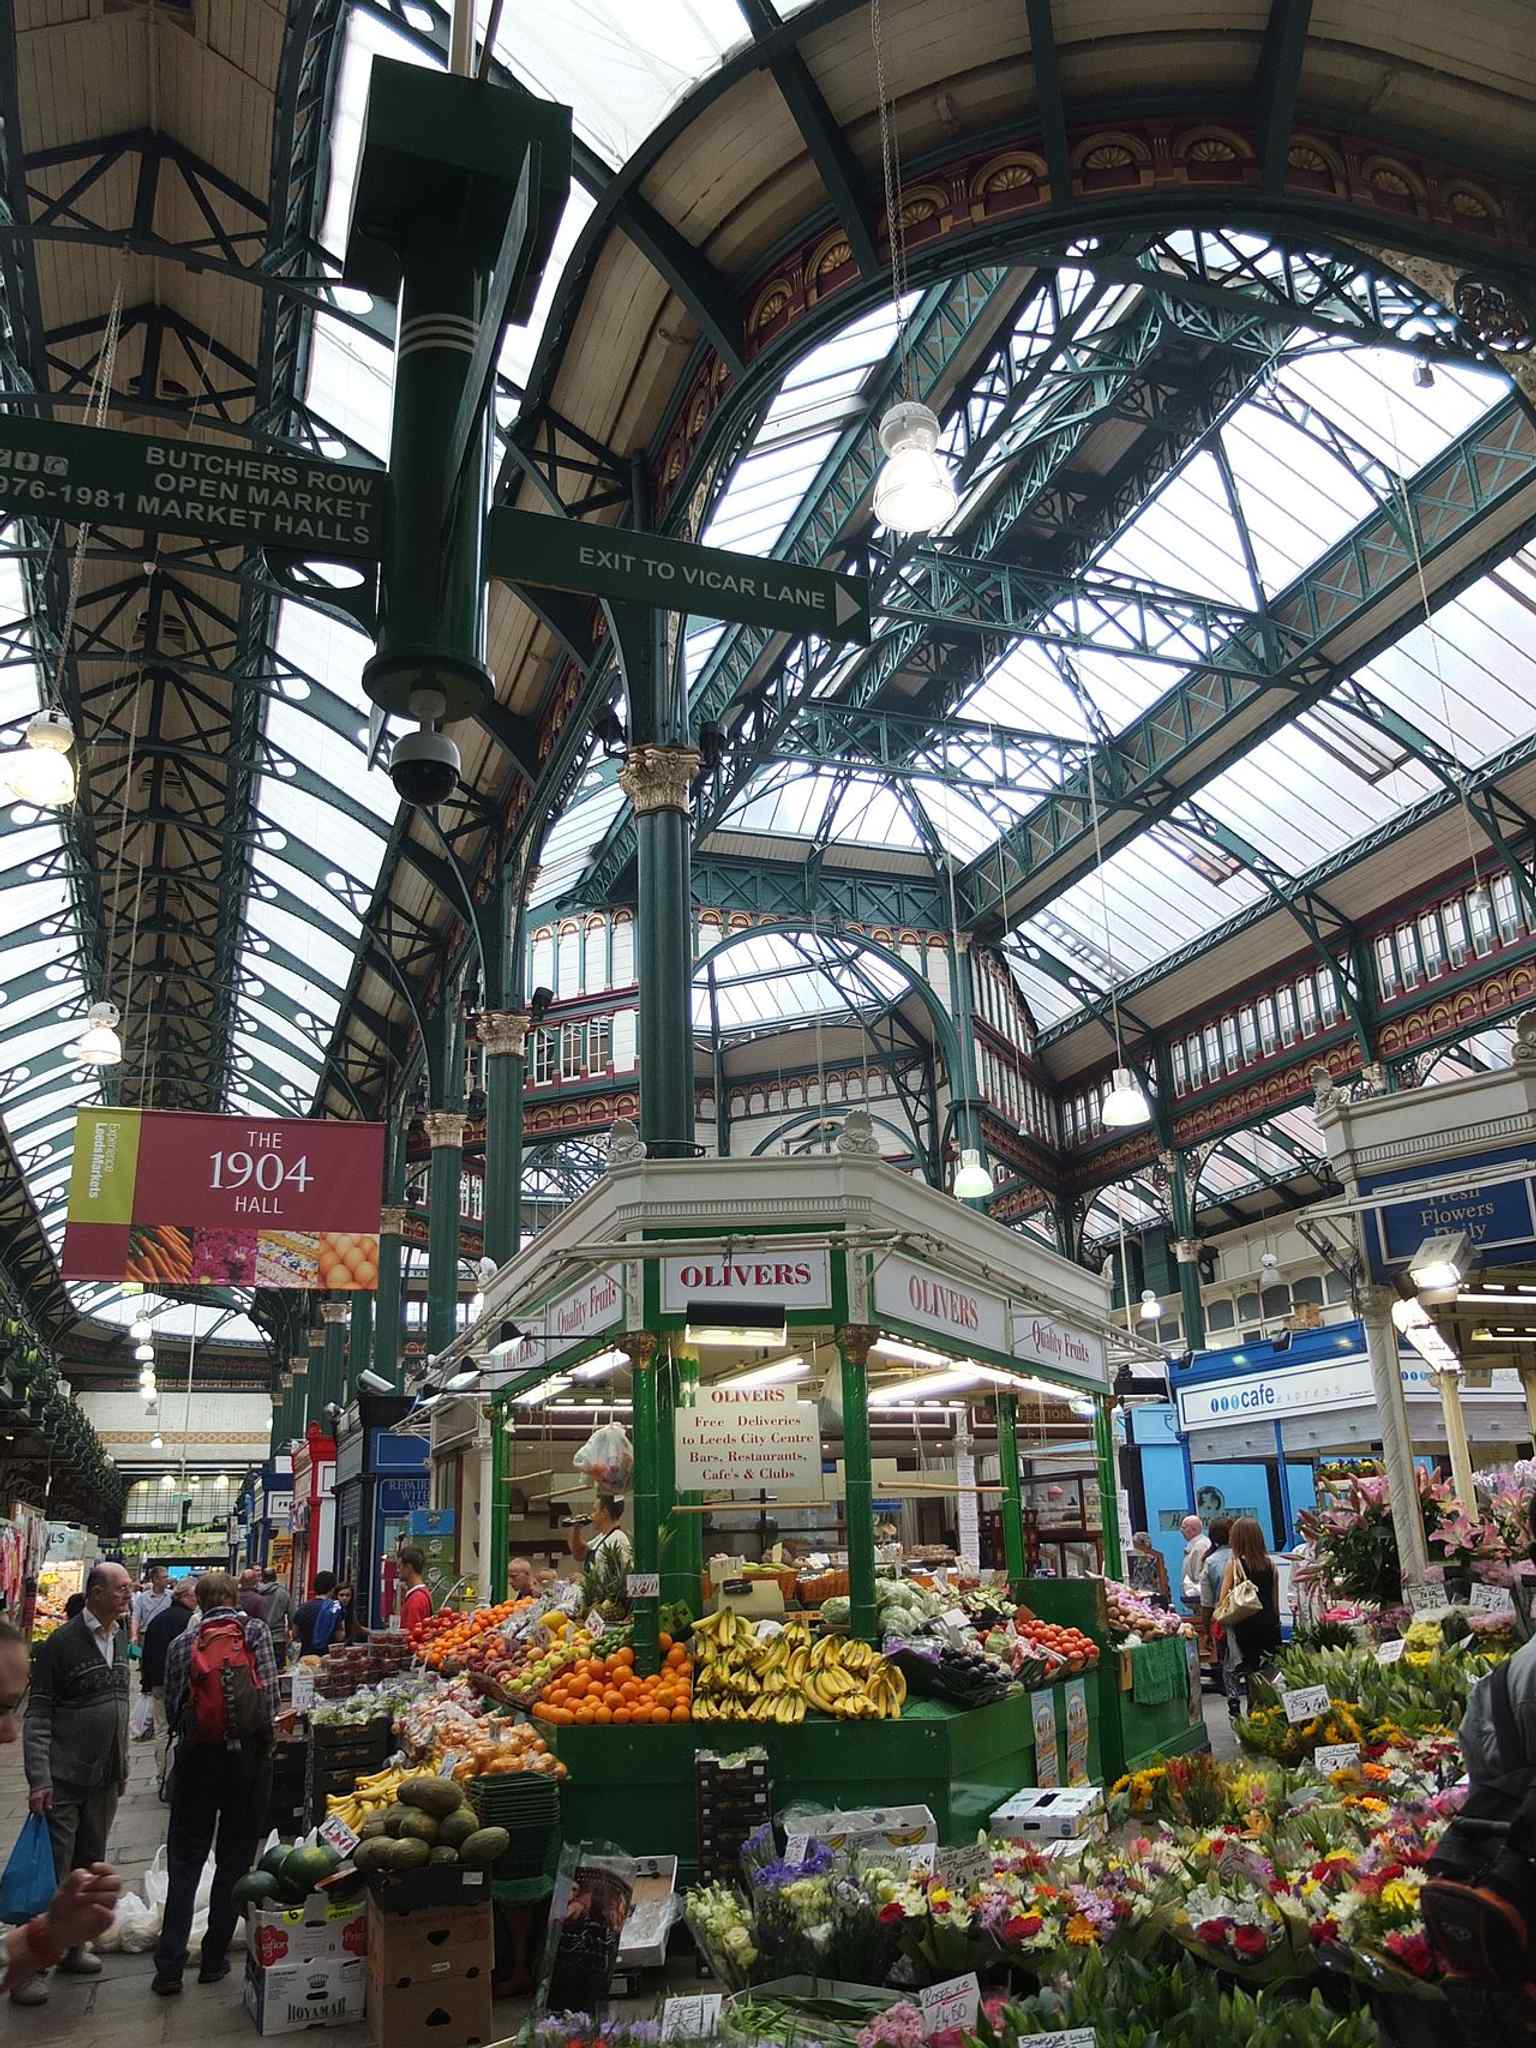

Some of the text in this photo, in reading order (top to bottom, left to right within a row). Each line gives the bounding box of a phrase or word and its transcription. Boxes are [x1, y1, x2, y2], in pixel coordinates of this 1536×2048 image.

[145, 446, 373, 496] BUTCHERS ROW
[154, 473, 372, 521] OPEN MARKET
[136, 496, 266, 530] MARKET
[274, 515, 370, 545] HALLS
[578, 546, 826, 610] EXIT TO VICAR LANE
[247, 1131, 284, 1149] THE
[209, 1151, 314, 1193] 1904
[235, 1196, 284, 1215] HALL
[1421, 1201, 1495, 1227] Flowers
[680, 1262, 813, 1289] OLIVERS
[557, 1278, 616, 1334] Quality Fruits
[908, 1275, 979, 1331] OLIVERS
[1031, 1319, 1090, 1363] Quality Fruits
[711, 1388, 786, 1403] OLIVERS
[695, 1414, 802, 1428] Free Deliveries
[682, 1432, 814, 1448] to Leeds City Centre
[728, 1450, 808, 1464] Restaurants,
[702, 1467, 795, 1481] Cafe's & Clubs
